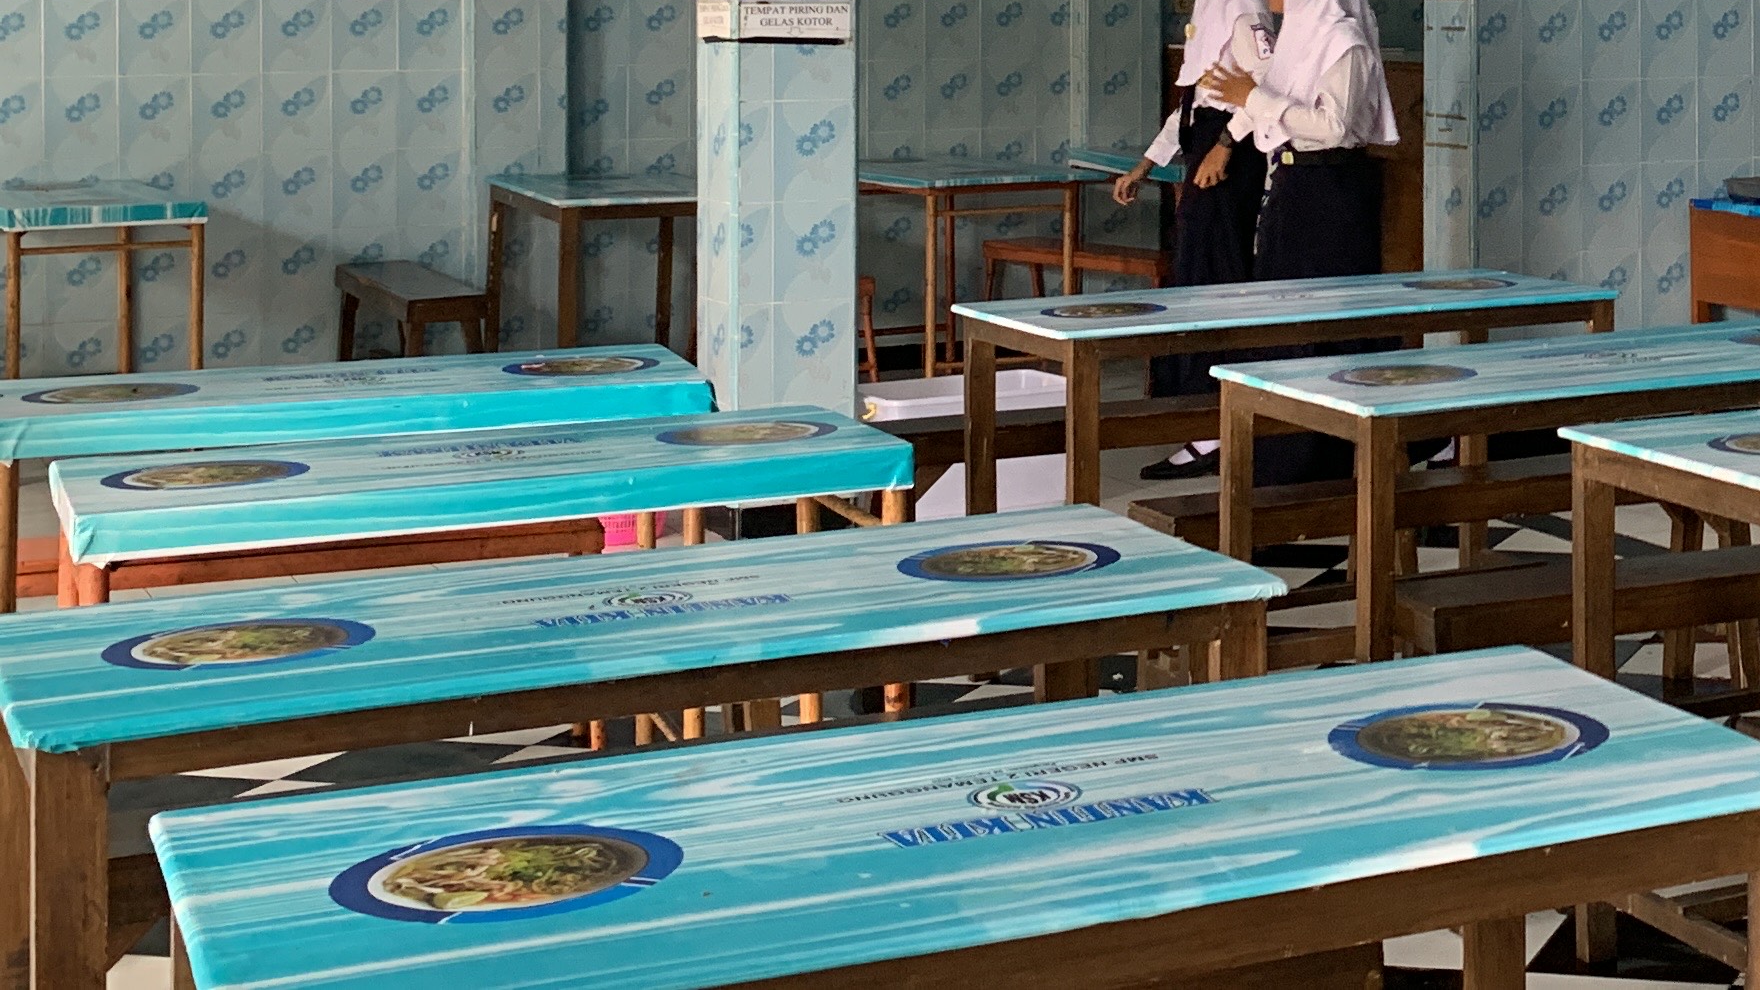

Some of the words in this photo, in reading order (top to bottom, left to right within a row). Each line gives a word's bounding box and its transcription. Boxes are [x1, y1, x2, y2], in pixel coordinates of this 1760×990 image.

[743, 6, 786, 16] TEMPAT
[789, 6, 824, 15] PIRING
[826, 5, 849, 15] DAN
[759, 18, 795, 28] GELAS
[796, 17, 834, 27] KOTOR
[1114, 752, 1160, 765] SMP
[1027, 760, 1107, 777] NEGERI
[836, 775, 1001, 804] TEMANGGUNG
[1002, 789, 1052, 806] KSM
